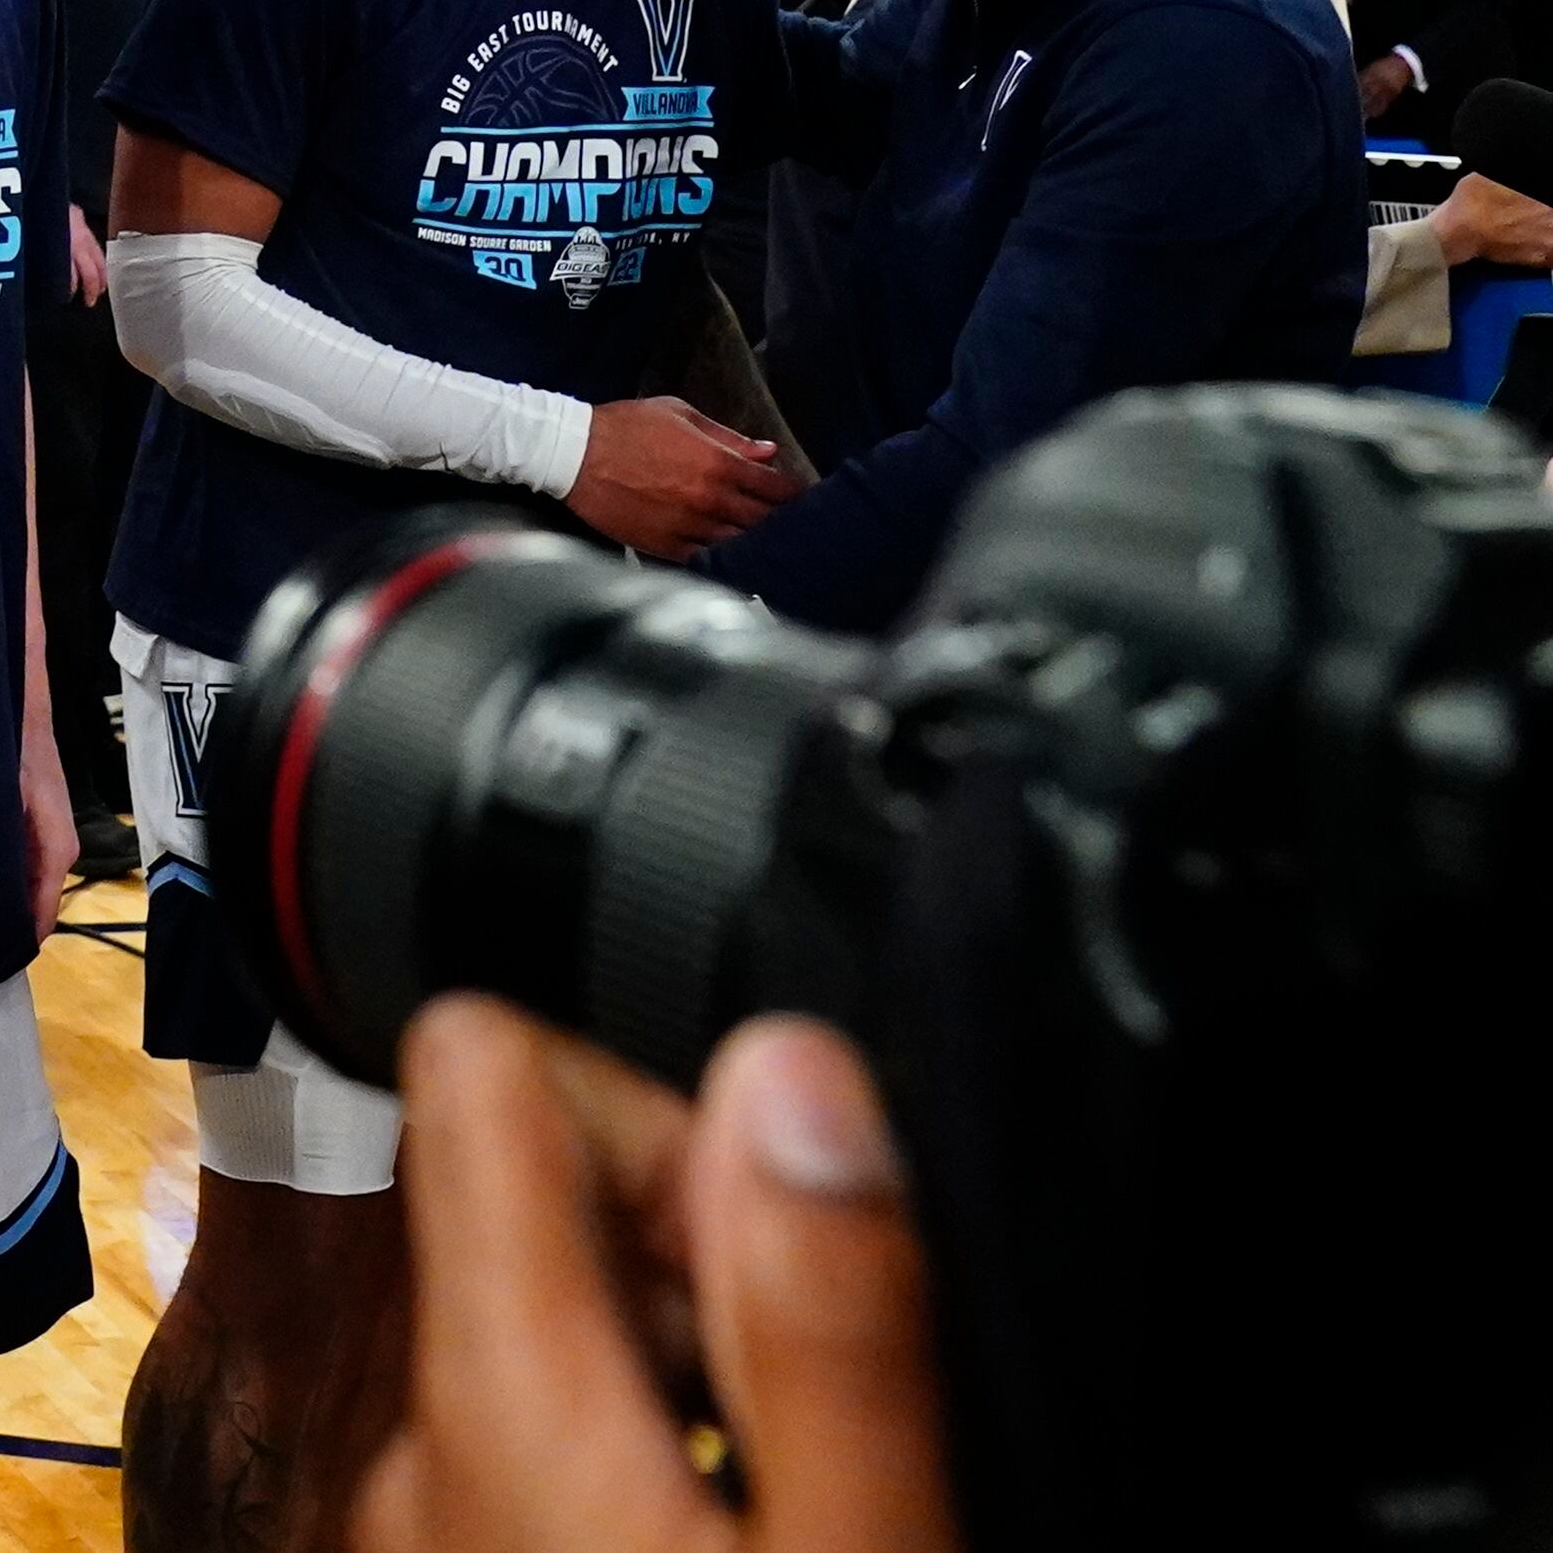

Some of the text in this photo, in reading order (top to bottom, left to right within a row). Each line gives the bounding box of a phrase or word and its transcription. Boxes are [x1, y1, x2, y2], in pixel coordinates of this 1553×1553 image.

[441, 10, 619, 114] BIG EAST TOURNAMENT
[632, 91, 700, 117] VILLANOVA
[416, 134, 720, 223] CHAMPIONS
[417, 227, 467, 247] MADISON
[509, 239, 553, 253] GARDEN
